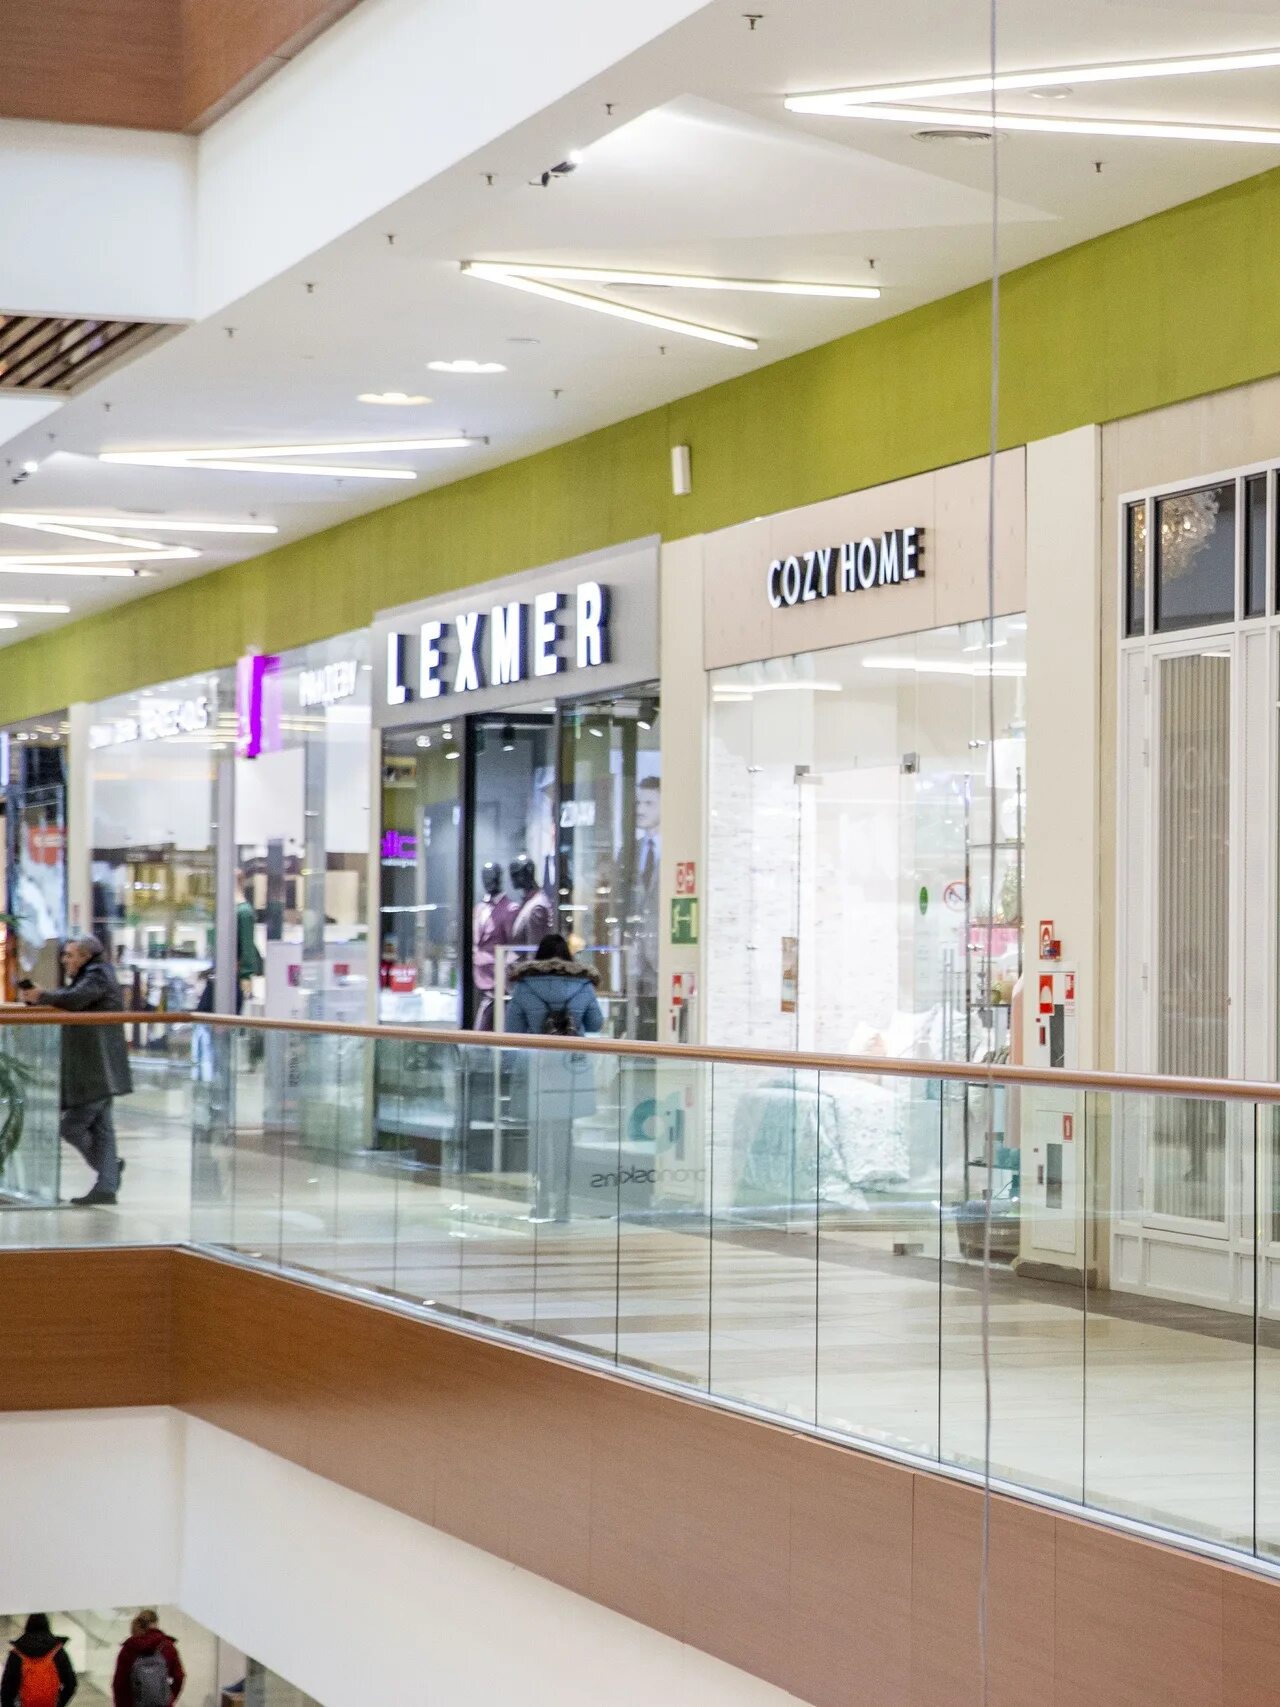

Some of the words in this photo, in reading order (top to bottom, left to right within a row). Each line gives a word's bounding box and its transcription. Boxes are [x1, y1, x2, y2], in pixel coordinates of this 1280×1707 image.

[767, 547, 834, 609] COZY
[840, 527, 919, 593] HOME
[387, 581, 609, 706] LEXMER
